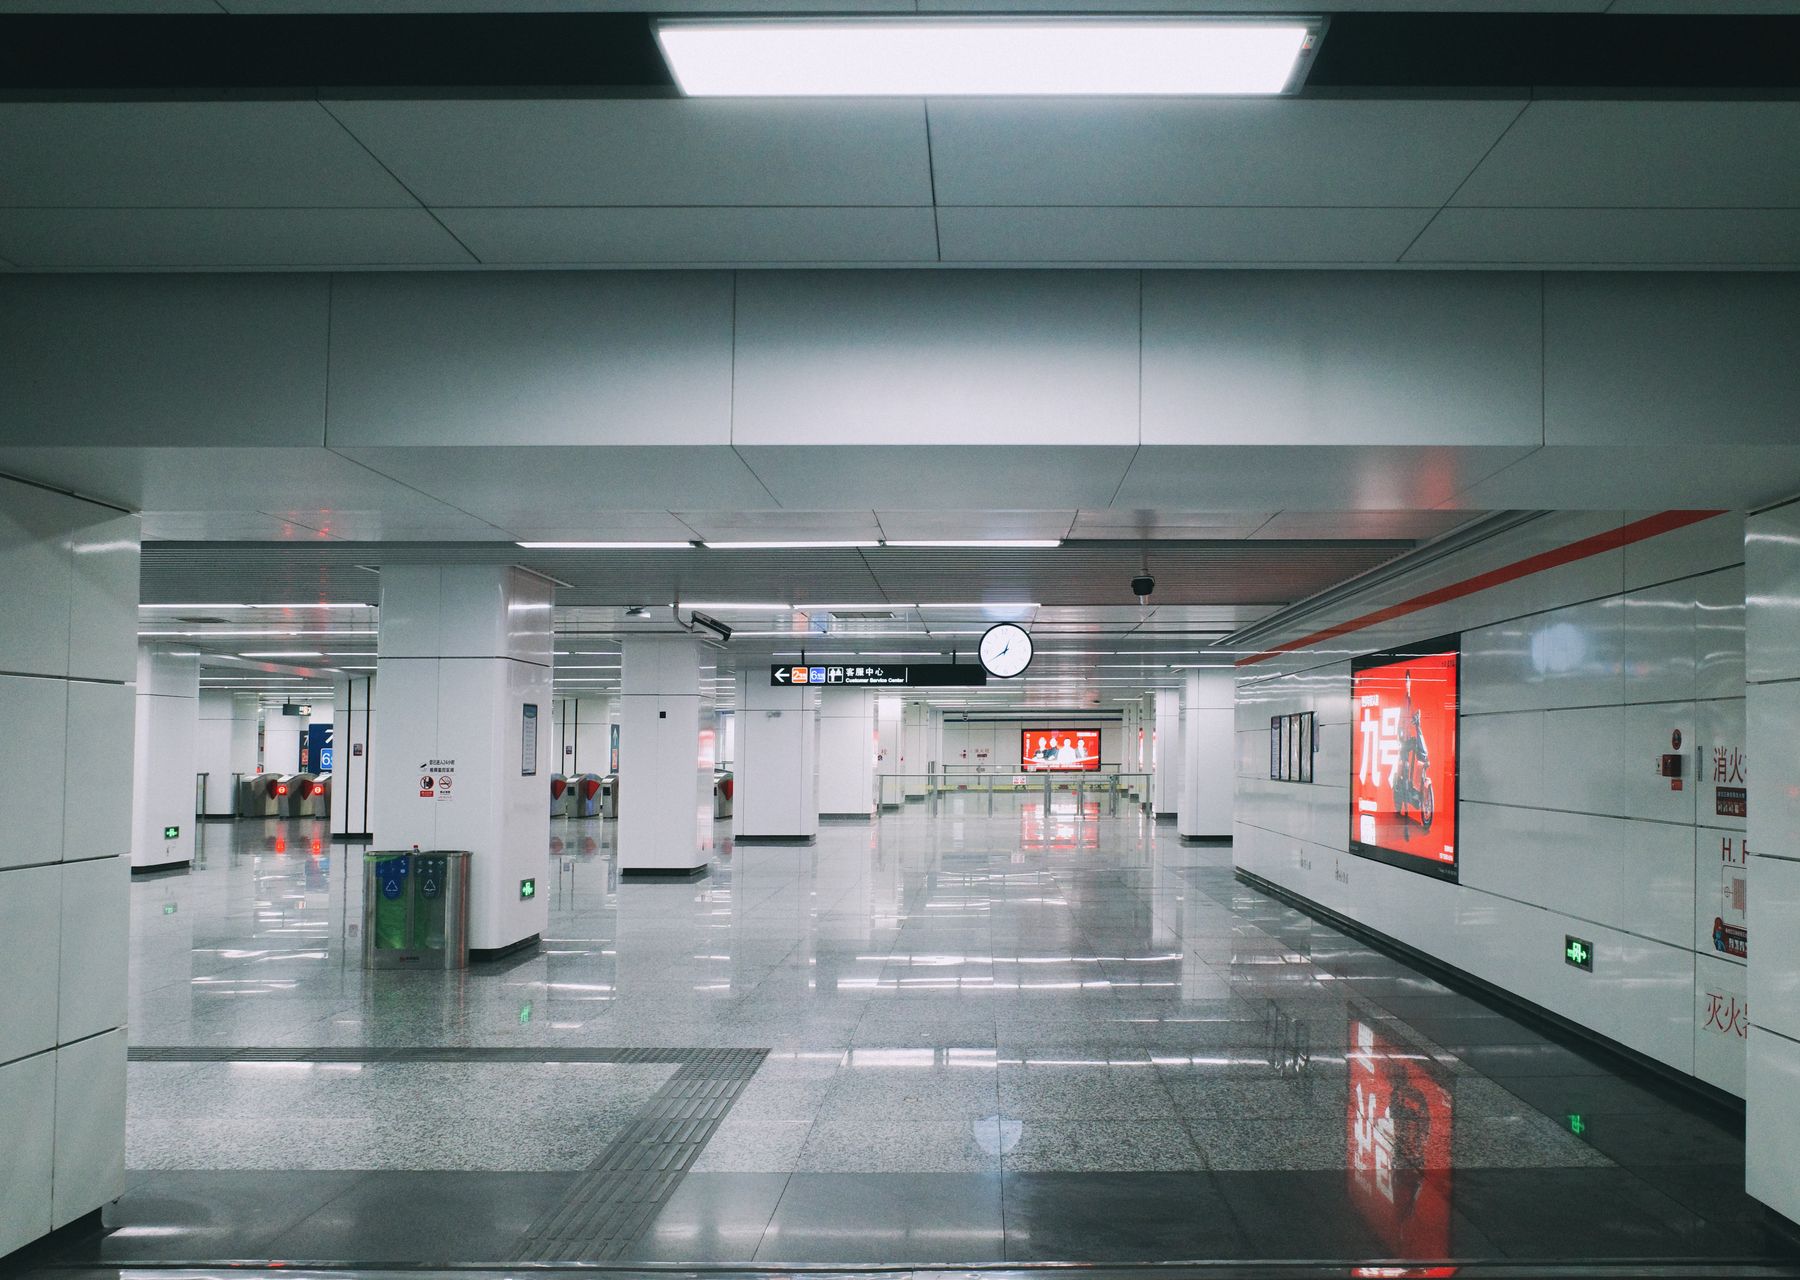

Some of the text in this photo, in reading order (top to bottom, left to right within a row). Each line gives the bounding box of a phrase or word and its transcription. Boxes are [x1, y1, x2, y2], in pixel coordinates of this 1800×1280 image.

[846, 667, 884, 676] 客服中心
[1713, 745, 1747, 783] 消火
